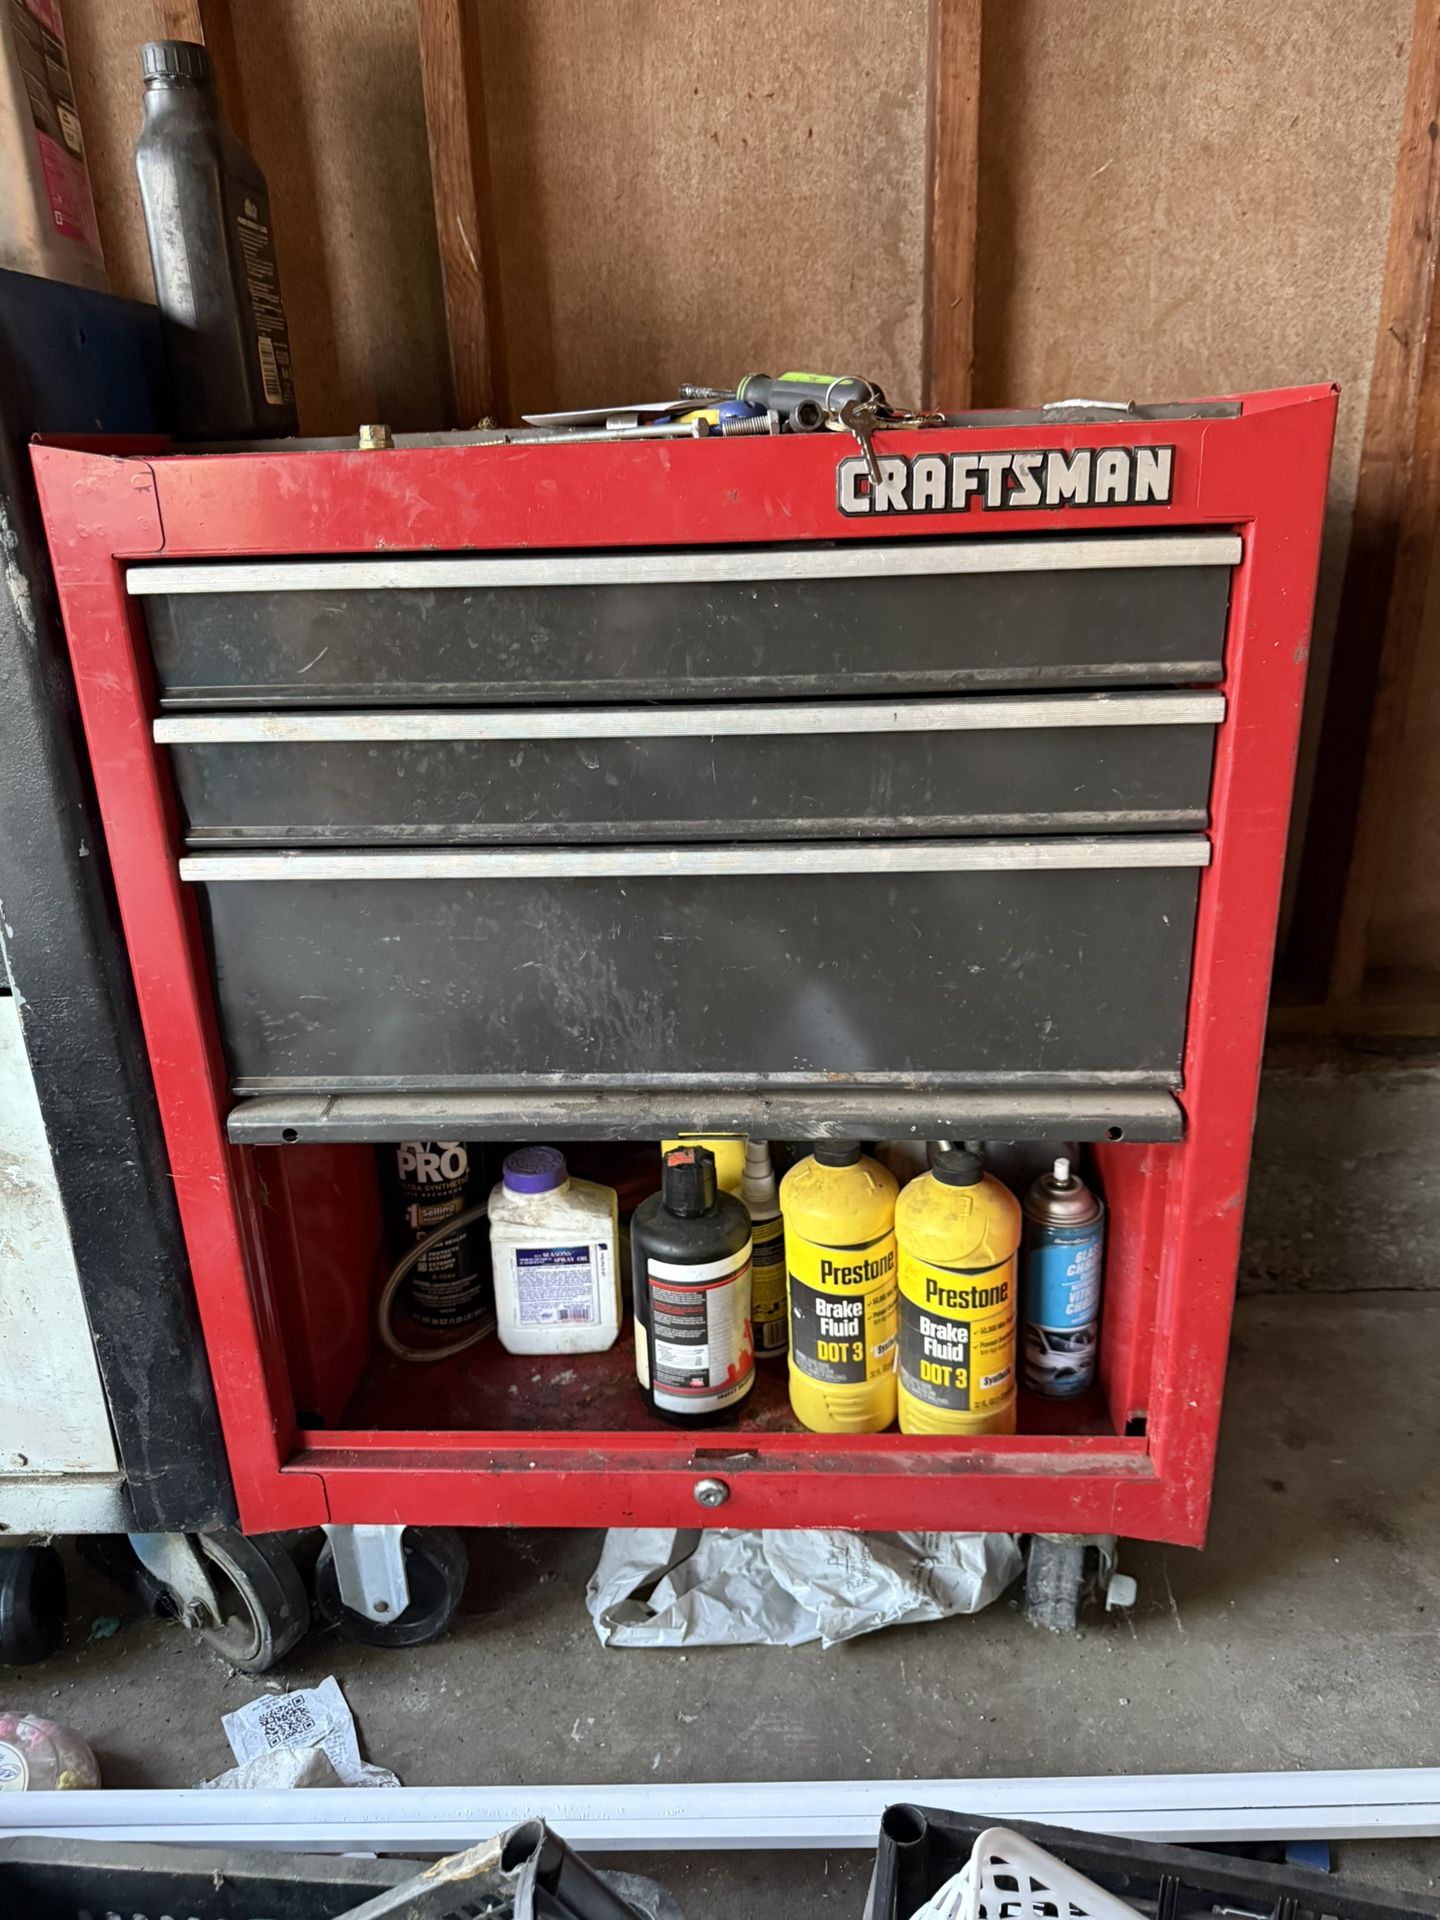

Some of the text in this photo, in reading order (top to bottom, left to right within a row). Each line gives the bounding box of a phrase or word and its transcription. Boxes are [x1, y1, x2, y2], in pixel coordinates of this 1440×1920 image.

[839, 447, 1173, 514] CRAFTSMAN
[396, 1146, 468, 1183] PRO
[424, 1177, 470, 1193] SYNTHETIC
[422, 1205, 455, 1217] Selling
[820, 1250, 894, 1286] Prestone
[926, 1278, 1008, 1310] Prestone
[815, 1298, 863, 1318] Brake
[820, 1317, 859, 1337] Fluid
[920, 1316, 968, 1341] Brake
[817, 1341, 863, 1362] DOT 3
[923, 1337, 964, 1362] Fluid
[920, 1359, 967, 1389] DOT 3
